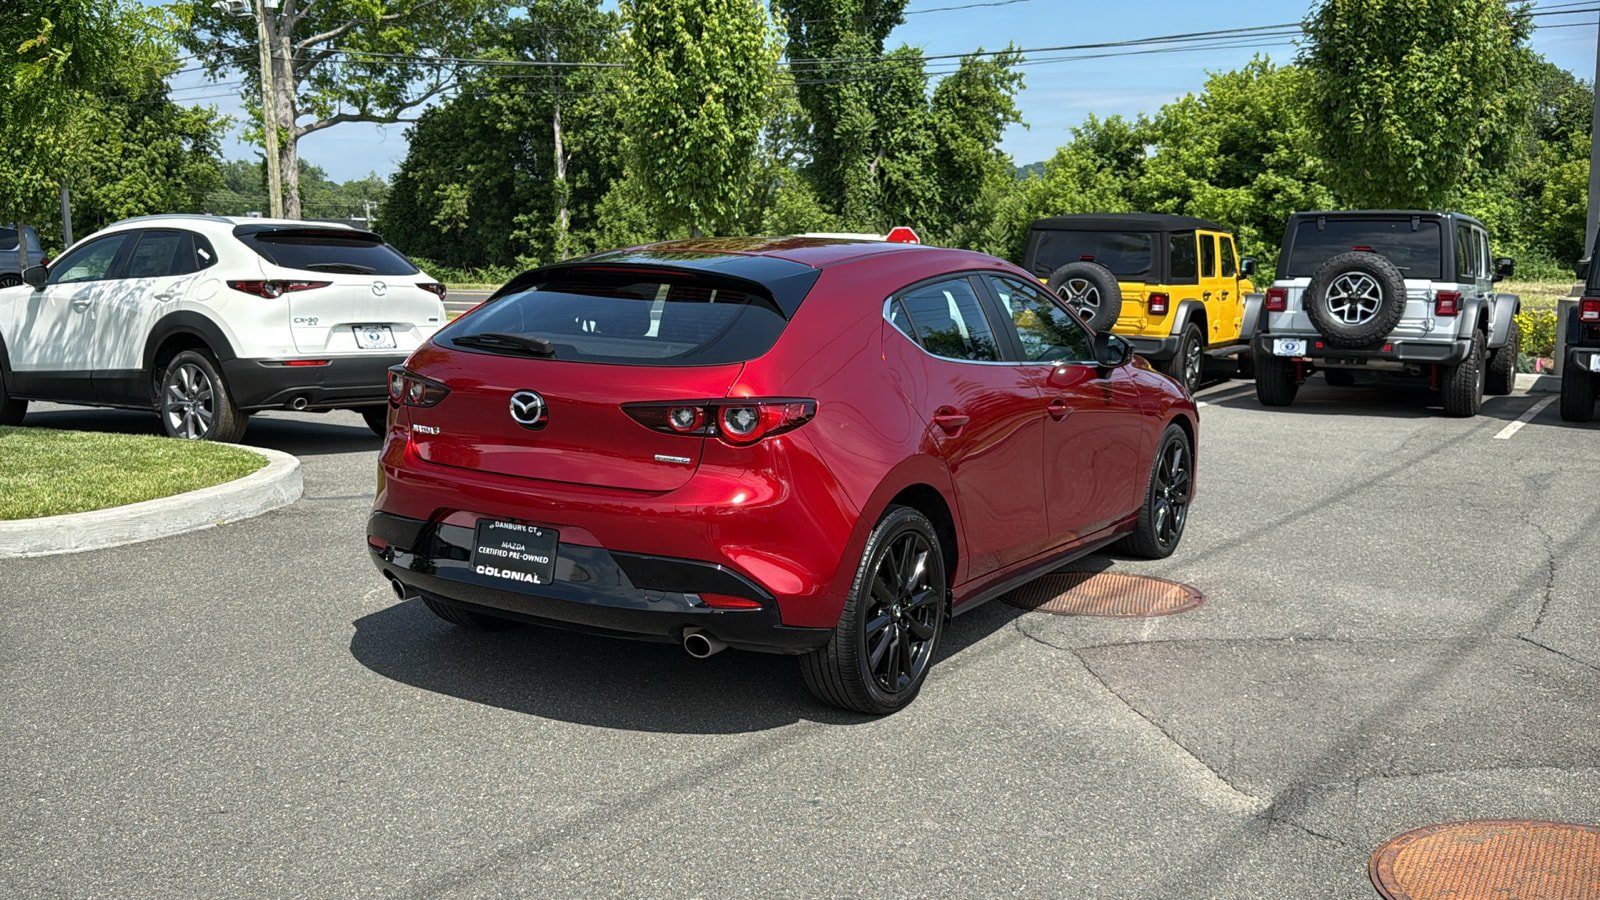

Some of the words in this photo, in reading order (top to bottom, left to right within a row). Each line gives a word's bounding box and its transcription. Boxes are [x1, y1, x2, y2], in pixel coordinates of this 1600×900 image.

[528, 526, 538, 534] CT
[501, 541, 526, 551] MAZDA
[478, 546, 508, 558] CERTIFIED
[508, 551, 548, 564] PRE-OWNED
[476, 565, 541, 584] COLONIAL
